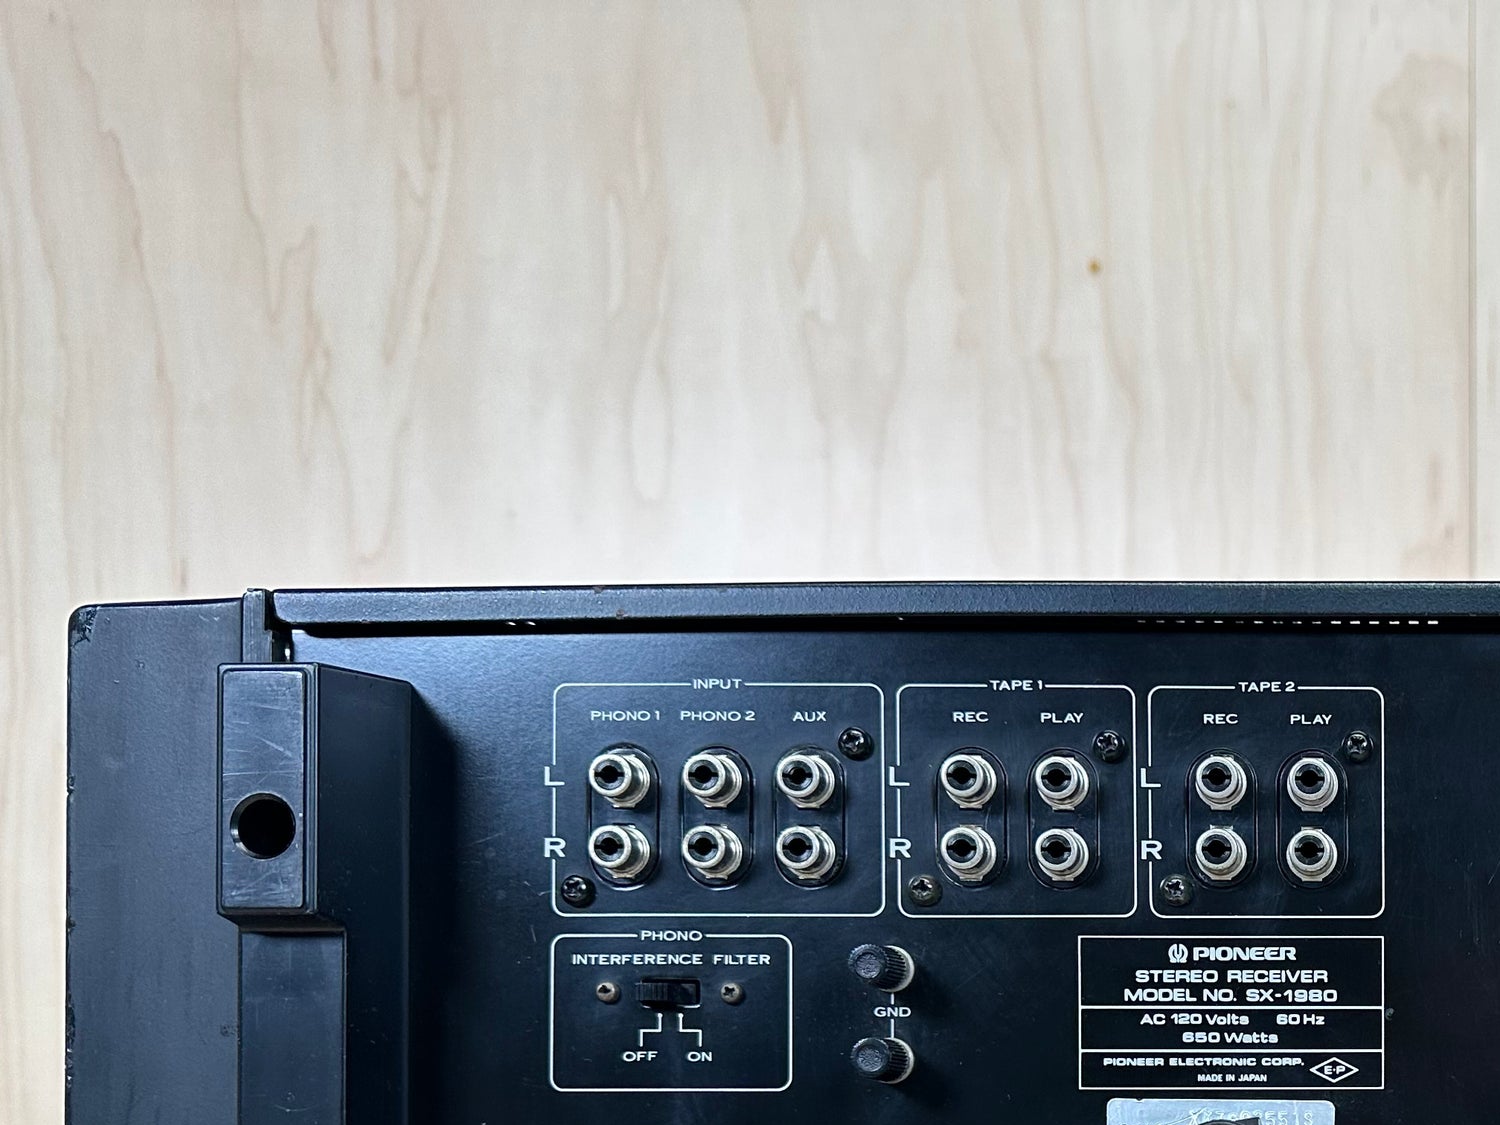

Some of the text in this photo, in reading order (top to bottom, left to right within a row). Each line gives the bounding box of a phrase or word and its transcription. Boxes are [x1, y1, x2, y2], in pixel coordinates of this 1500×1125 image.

[693, 679, 742, 689] INPUT
[990, 680, 1042, 690] TAPE 1
[1239, 682, 1295, 692] TAPE 2
[591, 711, 659, 721] PHONO 1
[680, 711, 755, 721] PHONO 2
[793, 711, 826, 722] AUX
[953, 712, 988, 722] REC
[1041, 713, 1083, 723] PLAY
[1204, 714, 1238, 724] REC
[1291, 715, 1332, 724] PLAY
[544, 764, 565, 788] L
[889, 764, 910, 786] L
[1141, 768, 1161, 787] L
[544, 838, 566, 860] R
[890, 838, 911, 860] R
[1141, 840, 1162, 862] R
[641, 930, 702, 941] PHONO
[572, 954, 770, 965] INTERFERENCE FILTER
[1193, 947, 1296, 961] PIONEER
[1136, 970, 1328, 983] STEREO RECEIVER
[1124, 989, 1337, 1002] MODEL NO. SX-1980
[874, 1007, 911, 1020] GND
[1140, 1013, 1324, 1025] AC 120 Volts 60 Hz
[1183, 1032, 1278, 1043] 650 Watts
[623, 1051, 658, 1061] OFF
[687, 1052, 712, 1061] ON
[1103, 1058, 1304, 1066] PIONEER ELECTRONIC CORP.
[1198, 1074, 1223, 1082] MADE
